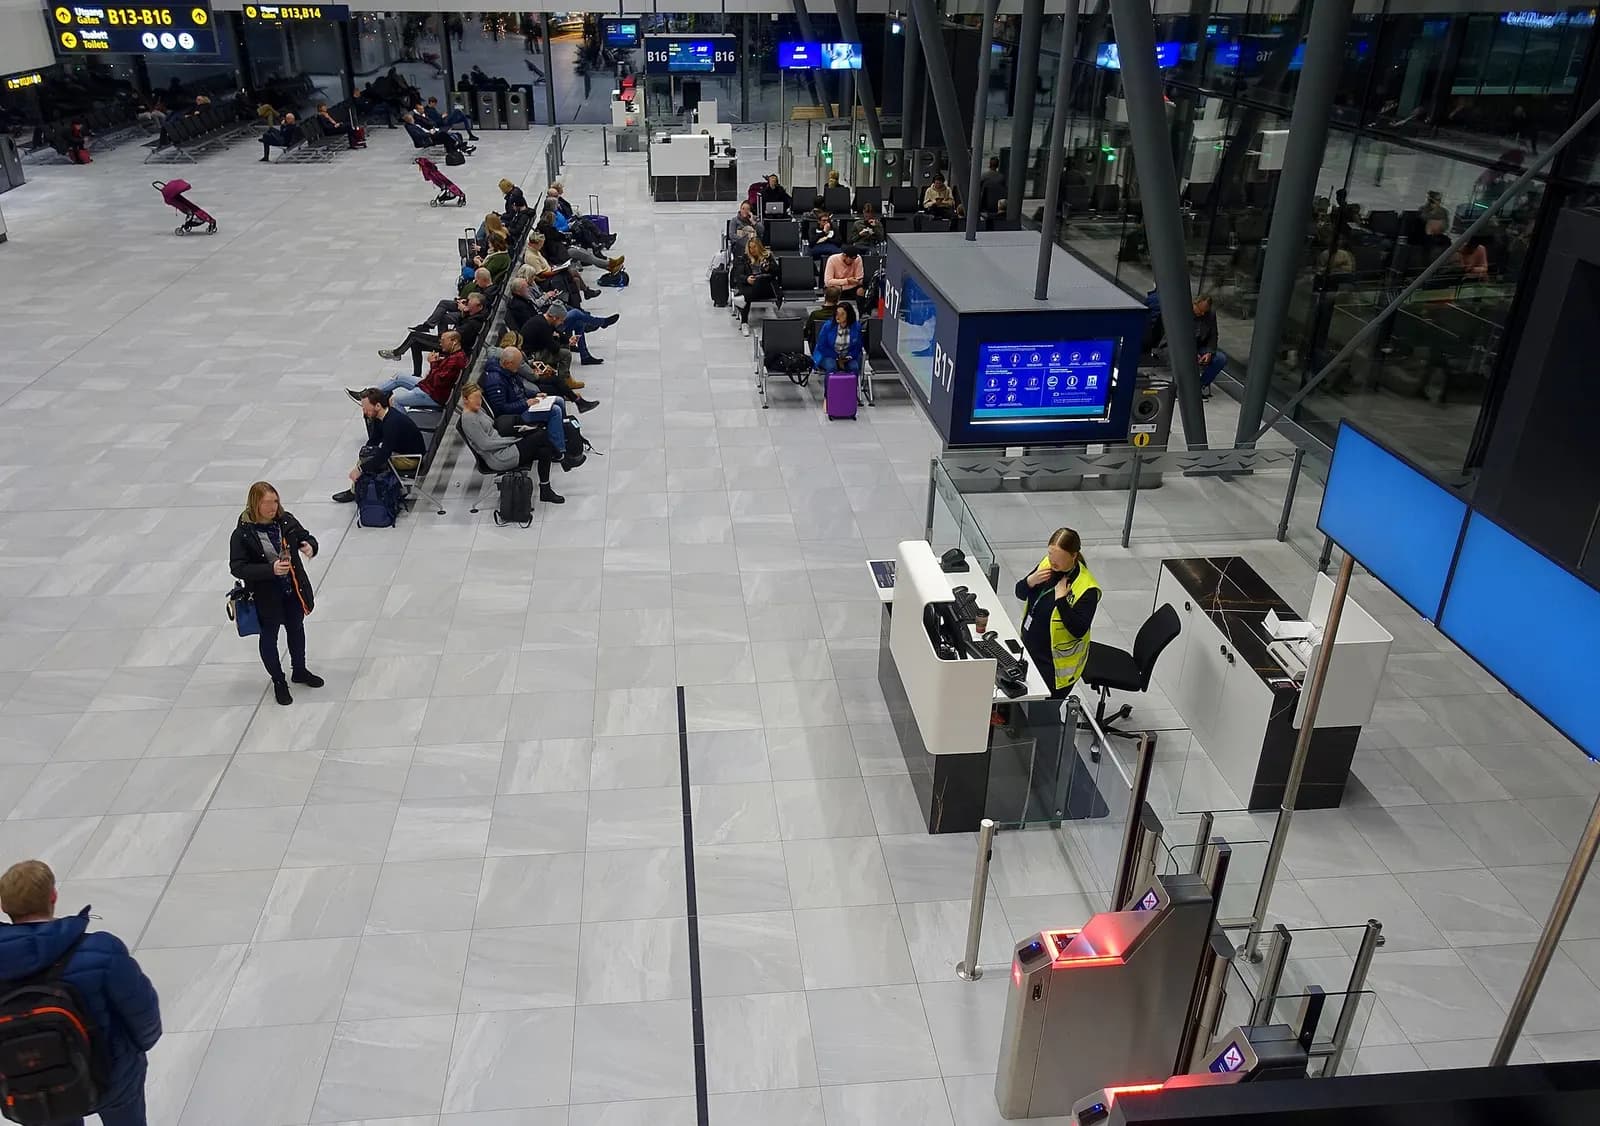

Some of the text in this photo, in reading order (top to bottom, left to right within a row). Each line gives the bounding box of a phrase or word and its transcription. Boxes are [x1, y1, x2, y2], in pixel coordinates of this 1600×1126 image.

[107, 9, 172, 25] B13-B16
[281, 7, 321, 20] B13,B14
[83, 40, 108, 49] Toilets
[647, 51, 667, 62] B16
[715, 51, 735, 62] B16
[885, 279, 899, 319] B17
[934, 341, 954, 393] B17
